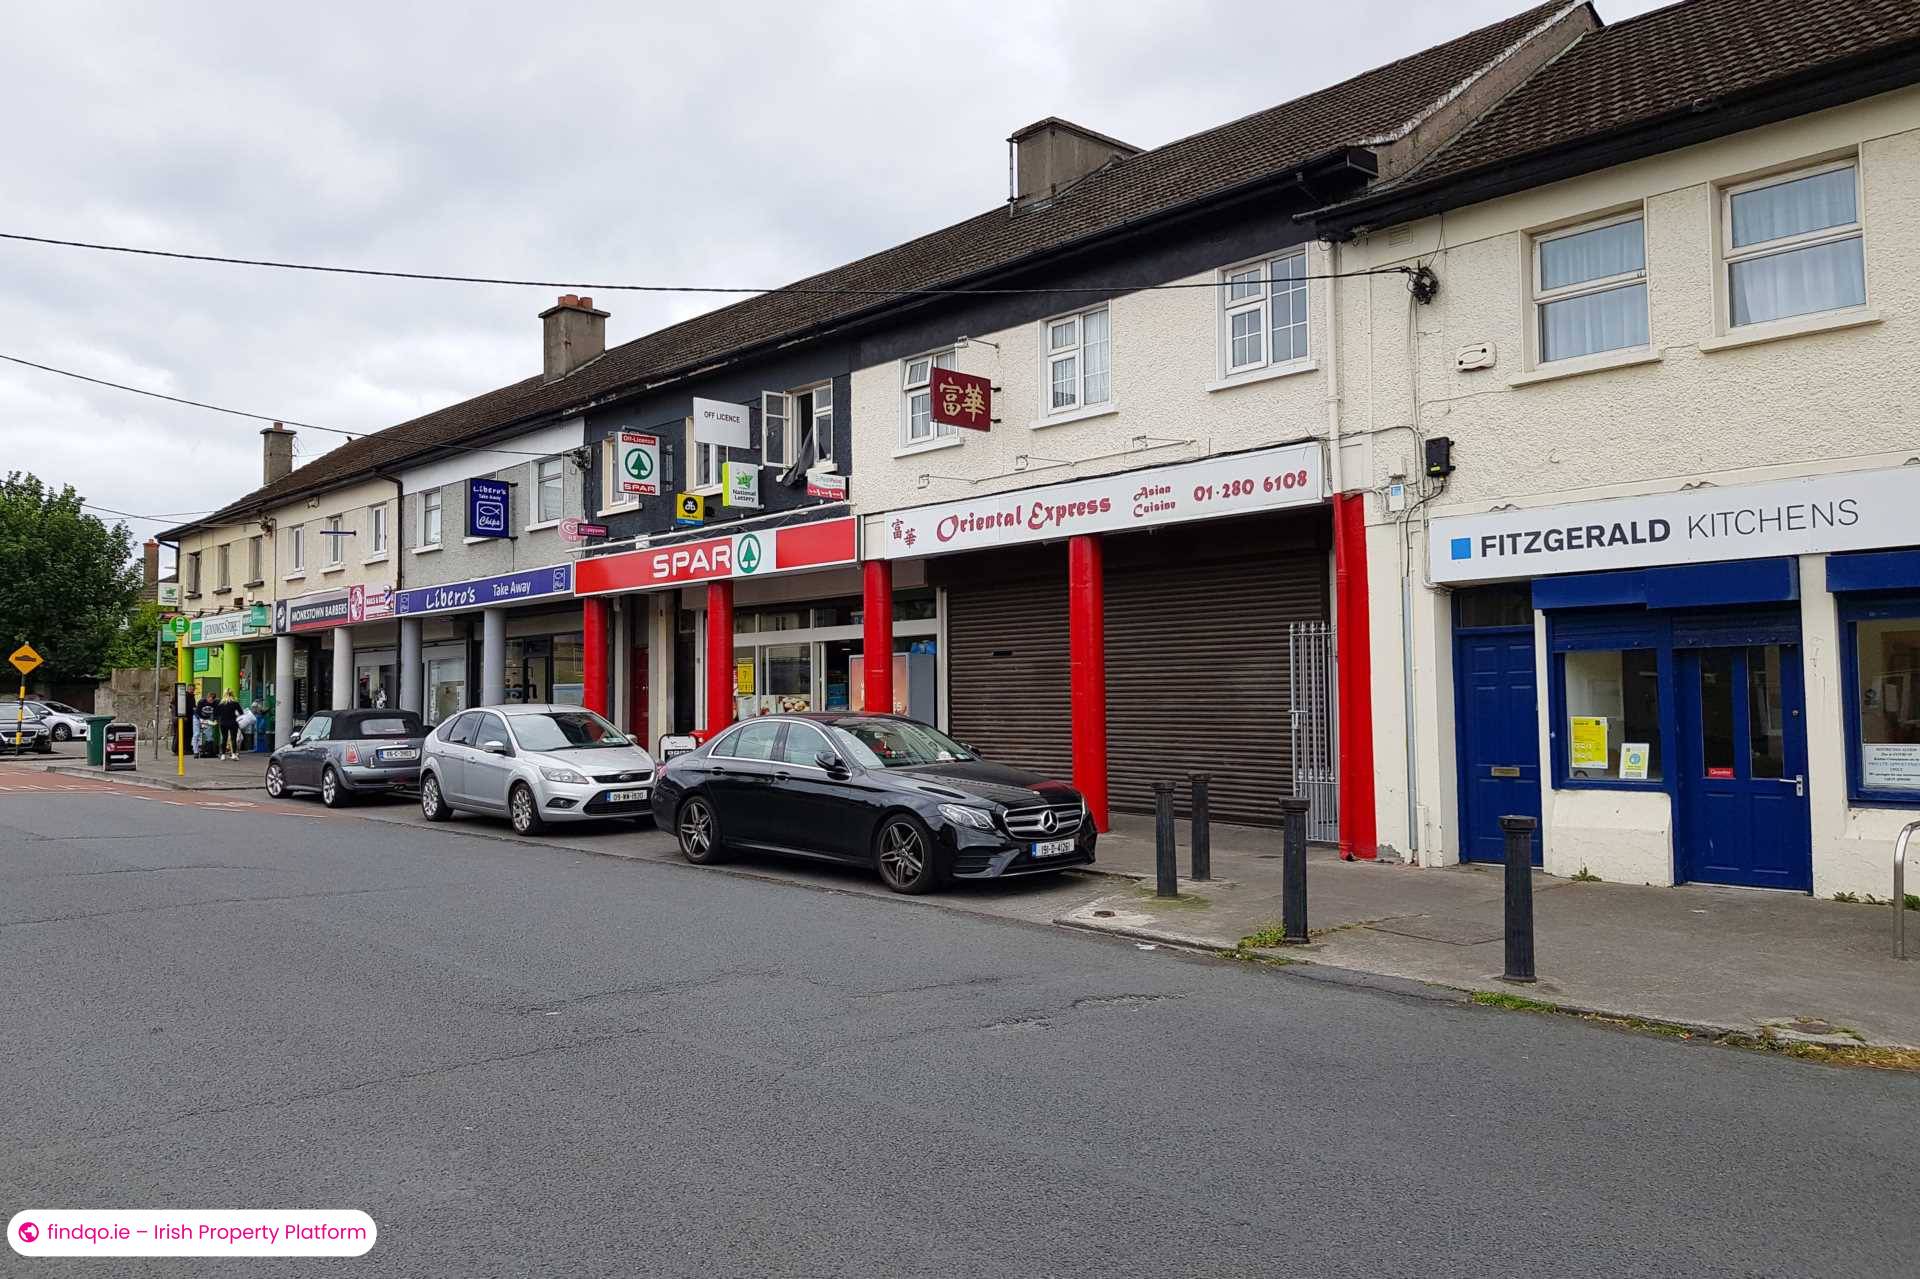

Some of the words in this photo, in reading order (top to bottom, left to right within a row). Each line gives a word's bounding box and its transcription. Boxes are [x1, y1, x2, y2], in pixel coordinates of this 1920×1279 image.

[939, 376, 986, 422] 富華
[703, 410, 715, 420] OFF
[716, 411, 741, 424] LICENCE
[624, 482, 656, 493] SPAR
[1263, 470, 1308, 493] 6108
[732, 488, 757, 497] National
[734, 495, 755, 504] Lottery
[1133, 484, 1172, 501] Asian
[479, 515, 501, 527] Chips
[936, 504, 1022, 543] Oriental
[1027, 497, 1111, 530] Express
[1480, 518, 1671, 558] FITZGERALD
[1687, 498, 1860, 540] KITCHENS
[652, 544, 732, 578] SPAR
[492, 583, 509, 597] Take
[510, 580, 532, 595] Away
[325, 603, 347, 617] BARBERS
